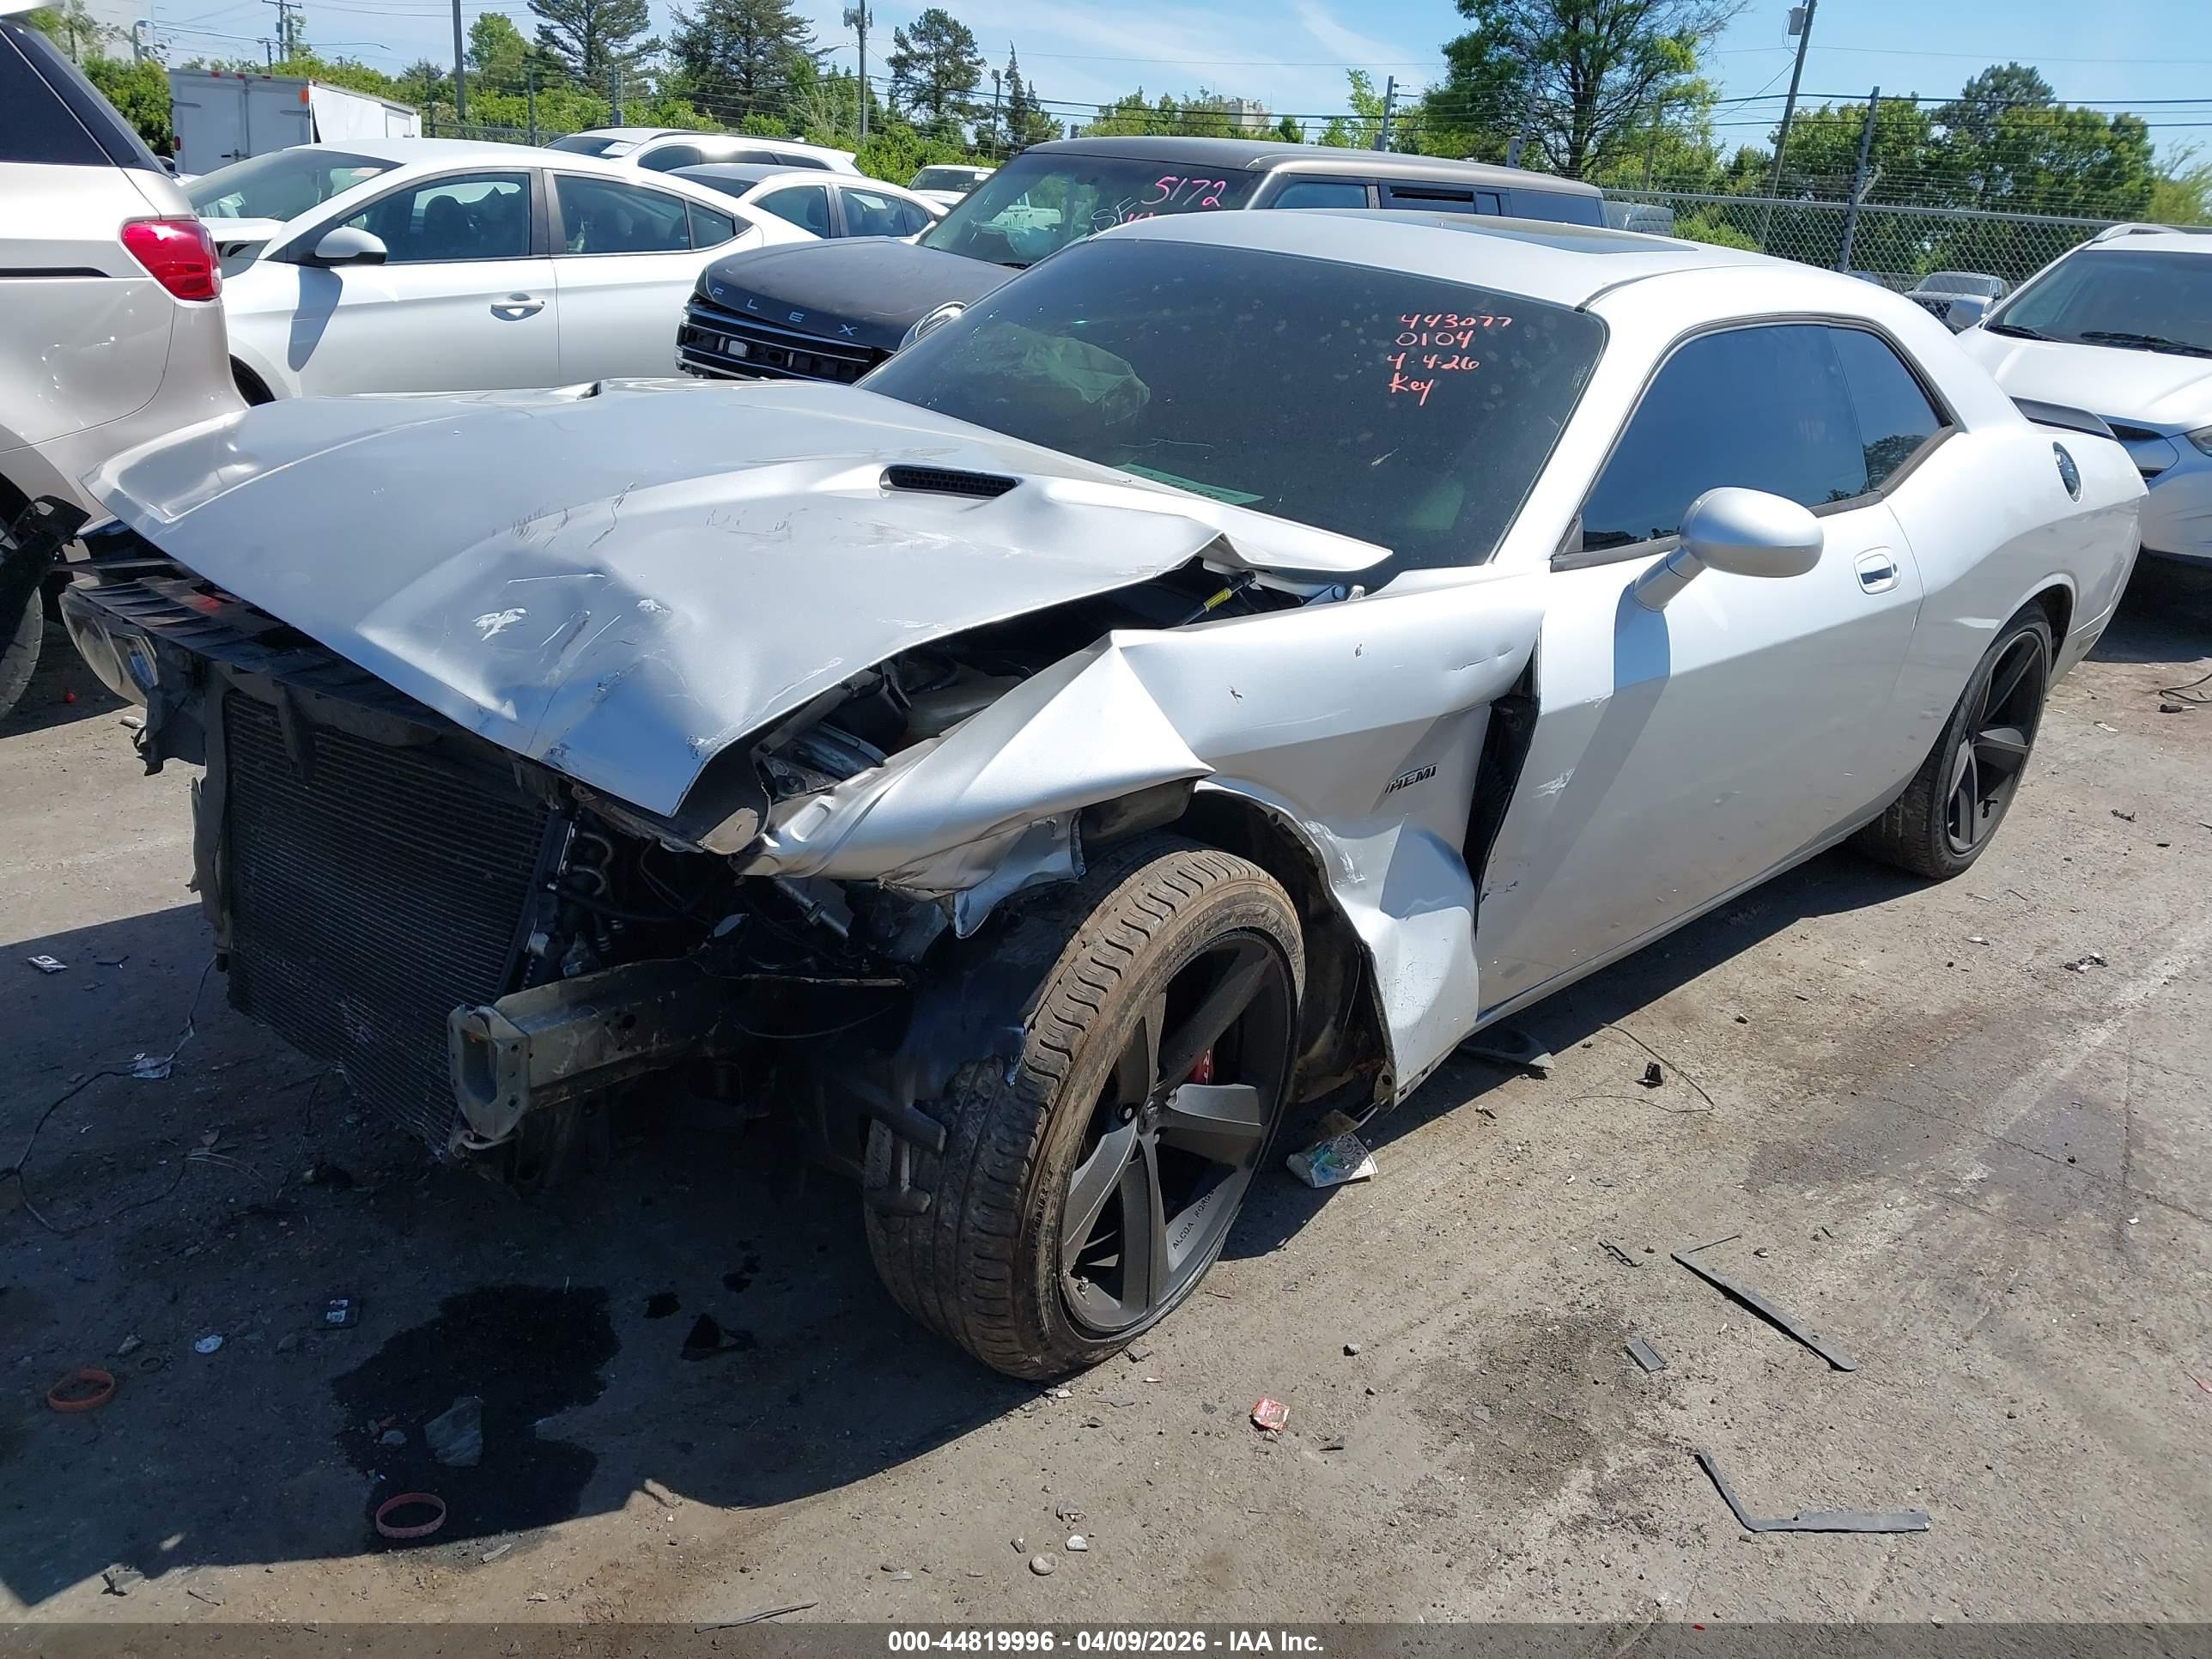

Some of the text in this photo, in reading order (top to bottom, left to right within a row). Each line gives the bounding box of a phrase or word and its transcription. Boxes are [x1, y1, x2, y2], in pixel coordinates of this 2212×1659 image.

[1140, 175, 1227, 207] 5172
[712, 287, 859, 336] FLEX
[1400, 313, 1513, 329] 443077
[1395, 330, 1474, 349] 0104
[1388, 372, 1435, 406] Key
[1384, 763, 1437, 794] HEMI
[1172, 1222, 1194, 1250] ALCOA
